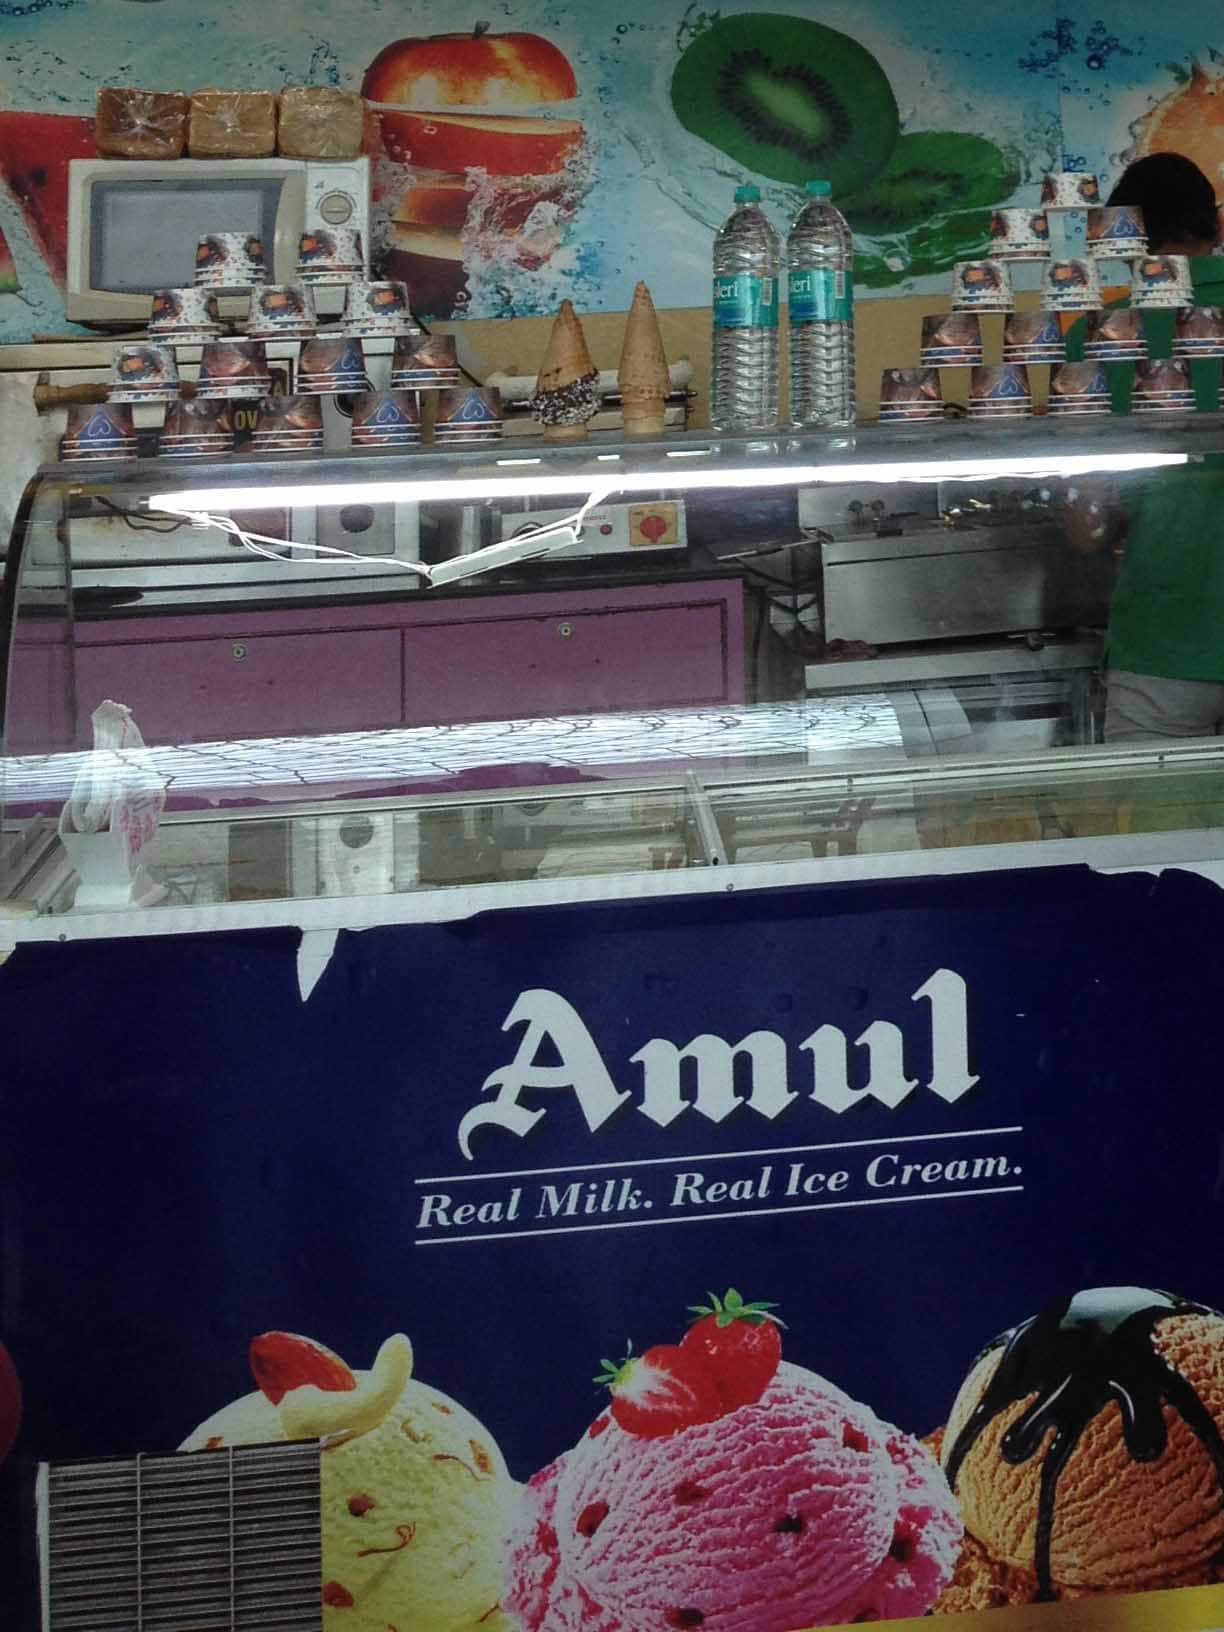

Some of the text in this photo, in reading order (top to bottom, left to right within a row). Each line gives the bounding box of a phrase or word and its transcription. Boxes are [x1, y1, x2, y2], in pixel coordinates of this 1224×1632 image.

[458, 967, 980, 1160] Amul
[415, 1151, 1023, 1229] Real Milk. Real Ice Cream.
